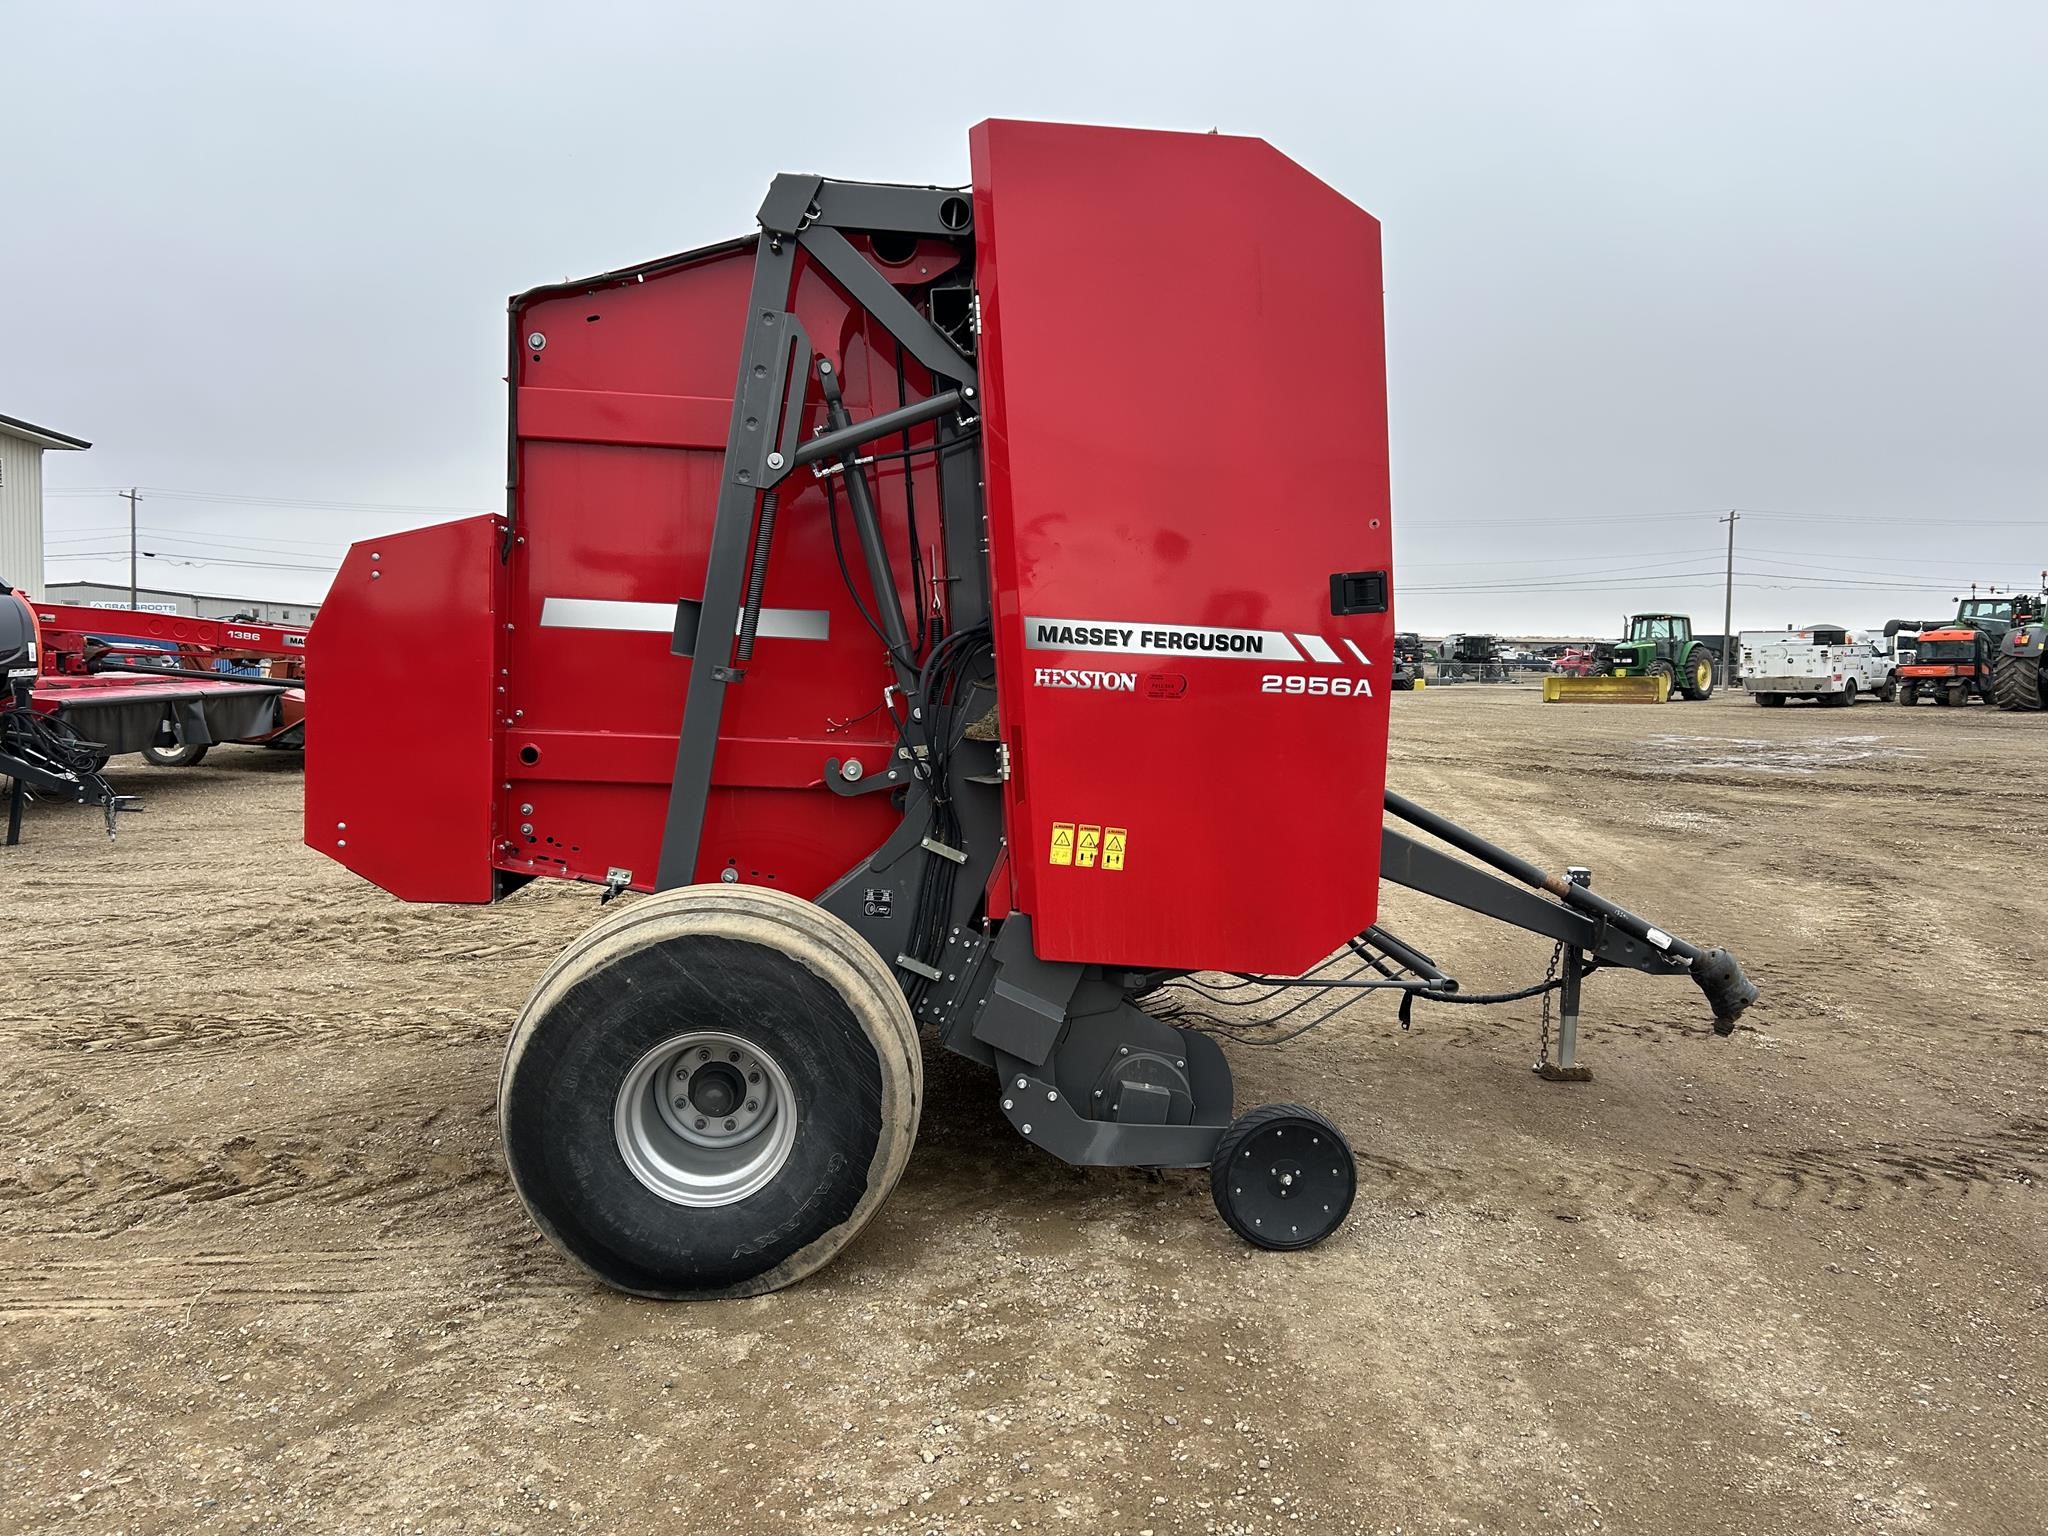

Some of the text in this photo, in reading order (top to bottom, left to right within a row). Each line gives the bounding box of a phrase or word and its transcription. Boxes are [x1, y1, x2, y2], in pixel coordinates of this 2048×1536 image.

[227, 630, 261, 641] 1386
[289, 637, 305, 645] MA
[1037, 625, 1263, 653] MASSEY FERGUSON
[1034, 668, 1137, 692] HESSTON
[1261, 674, 1373, 698] 2956A
